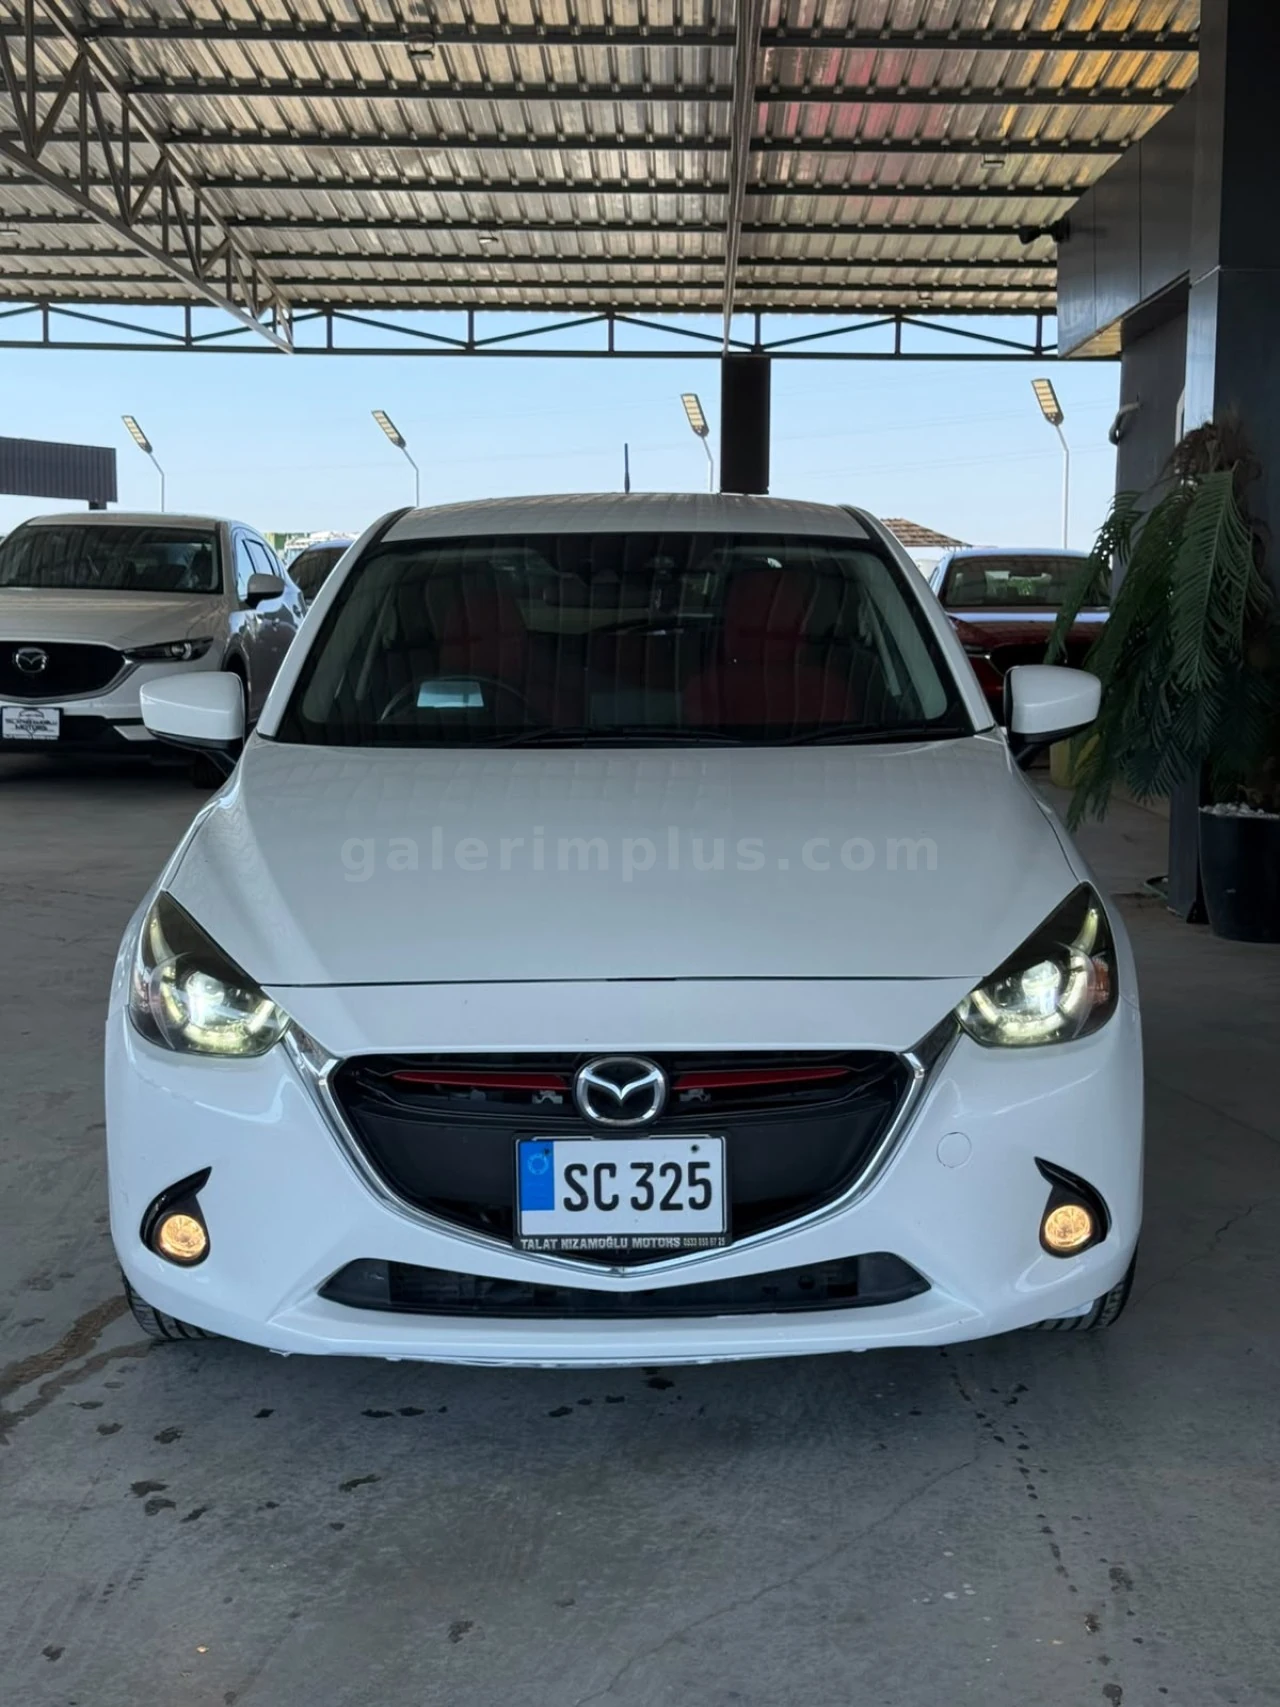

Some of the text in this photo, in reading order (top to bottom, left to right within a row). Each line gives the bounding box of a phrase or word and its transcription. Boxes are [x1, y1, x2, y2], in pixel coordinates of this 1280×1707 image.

[563, 1161, 713, 1212] SC 325
[520, 1238, 558, 1250] TALAT
[632, 1237, 681, 1249] MOTORS
